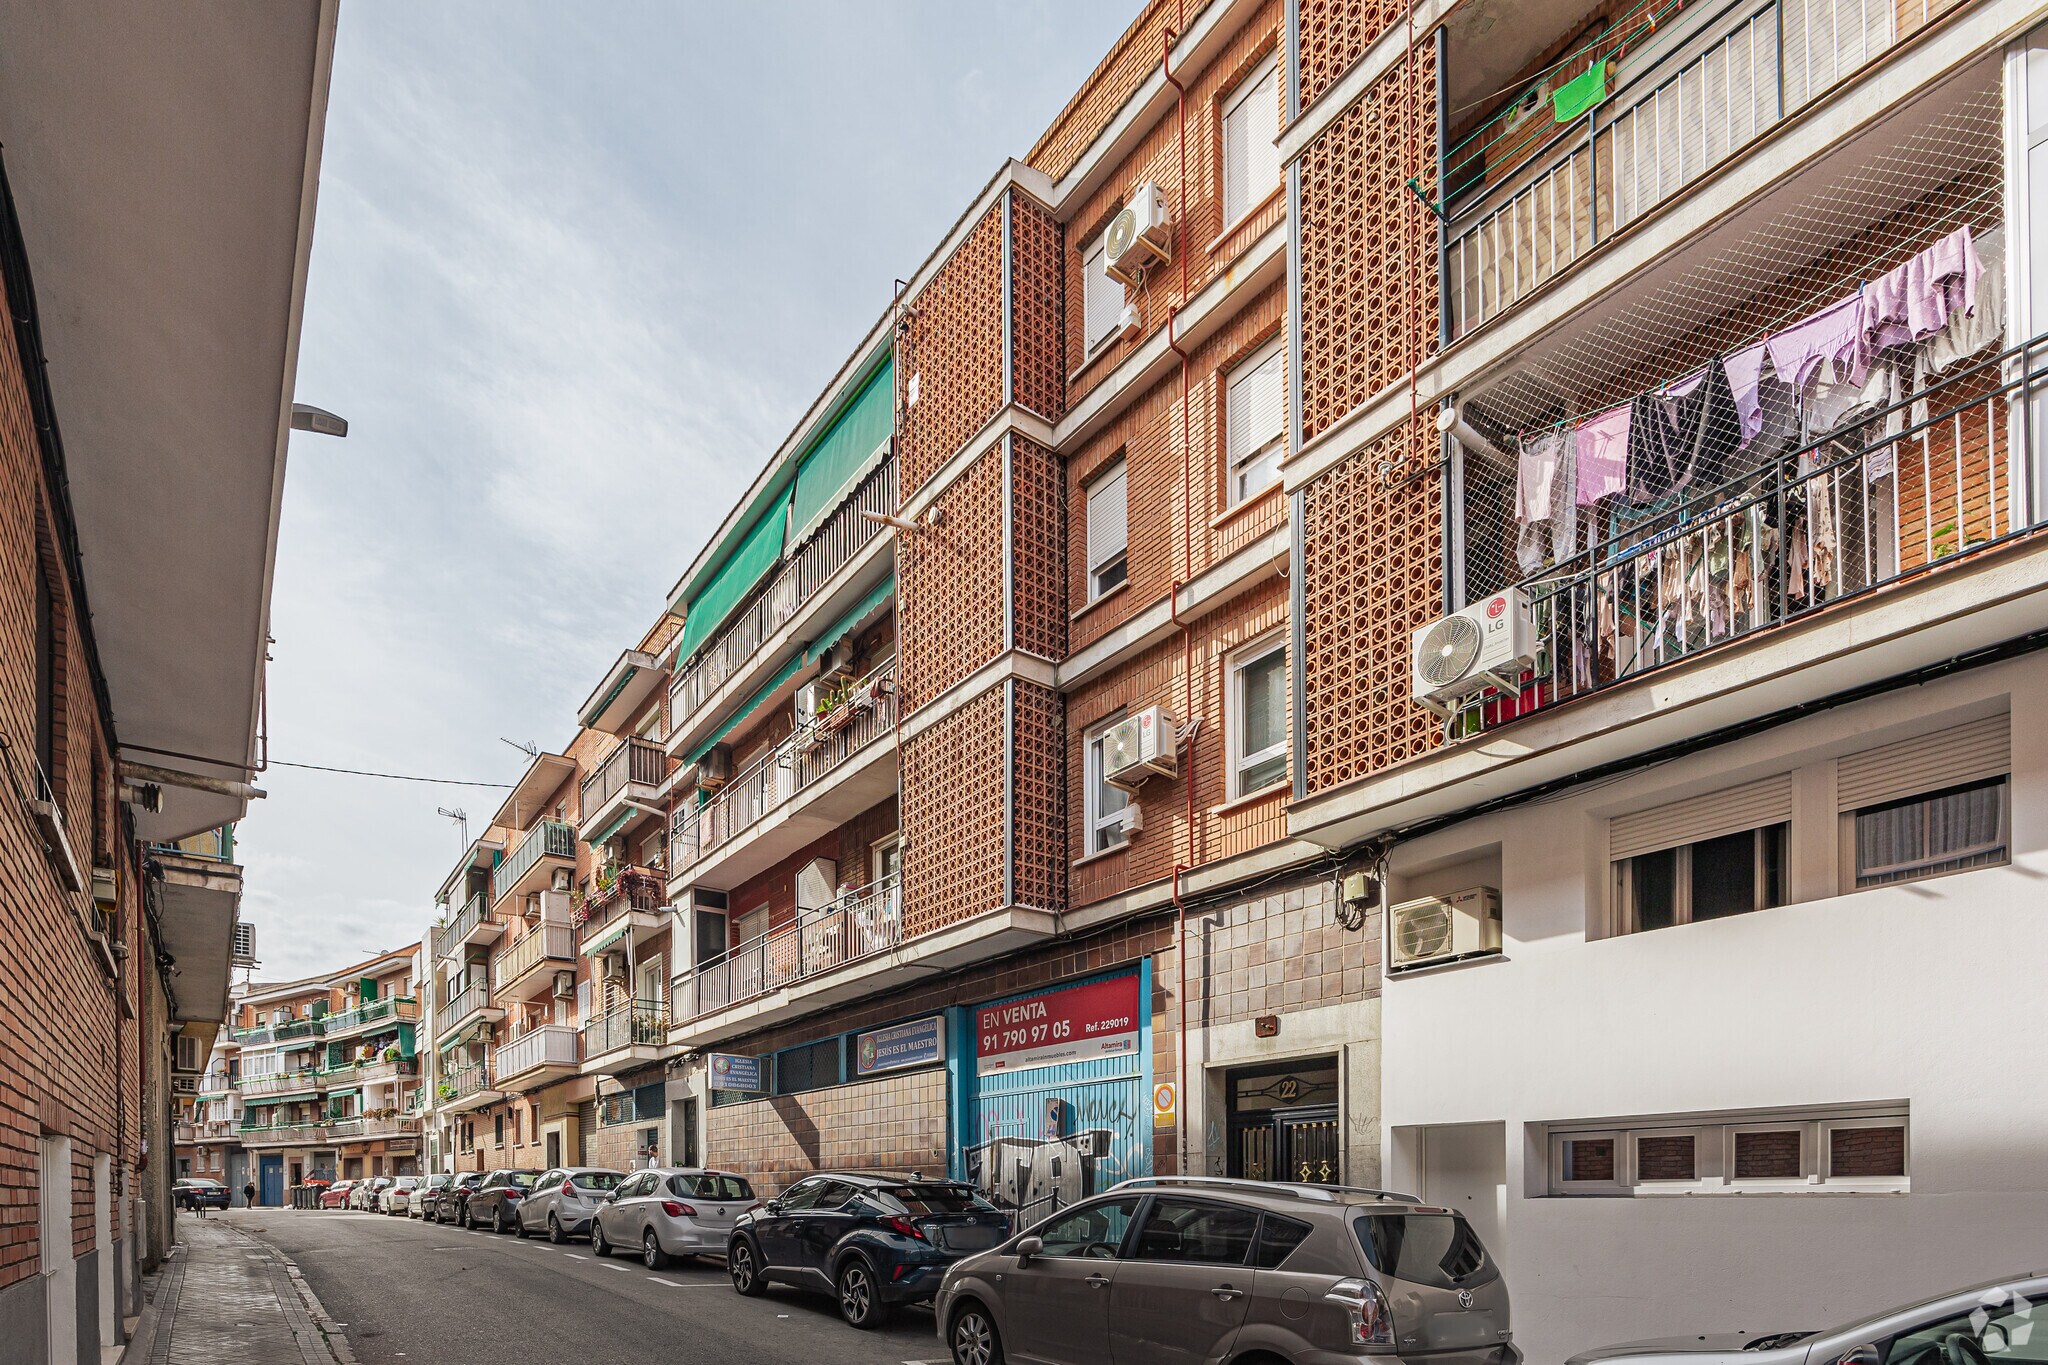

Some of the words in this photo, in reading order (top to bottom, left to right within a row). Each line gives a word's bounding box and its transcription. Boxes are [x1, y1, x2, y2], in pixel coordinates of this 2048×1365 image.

[1488, 619, 1504, 634] LG
[1143, 729, 1151, 738] LG
[983, 1011, 1000, 1029] EN
[1002, 1001, 1047, 1025] VENTA
[1085, 1022, 1099, 1033] Ref.
[1100, 1016, 1129, 1031] 229019
[891, 1028, 911, 1040] CRISTIANA
[983, 1034, 998, 1051] 91
[1002, 1028, 1027, 1048] 790
[1031, 1024, 1048, 1042] 97
[1052, 1019, 1071, 1039] 05
[893, 1045, 899, 1054] ES
[901, 1044, 907, 1052] EL
[908, 1037, 936, 1051] MAESTRO
[1100, 1040, 1123, 1050] Altamira
[1025, 1050, 1077, 1063] altamirainmuebles.com
[1281, 1080, 1297, 1098] 22
